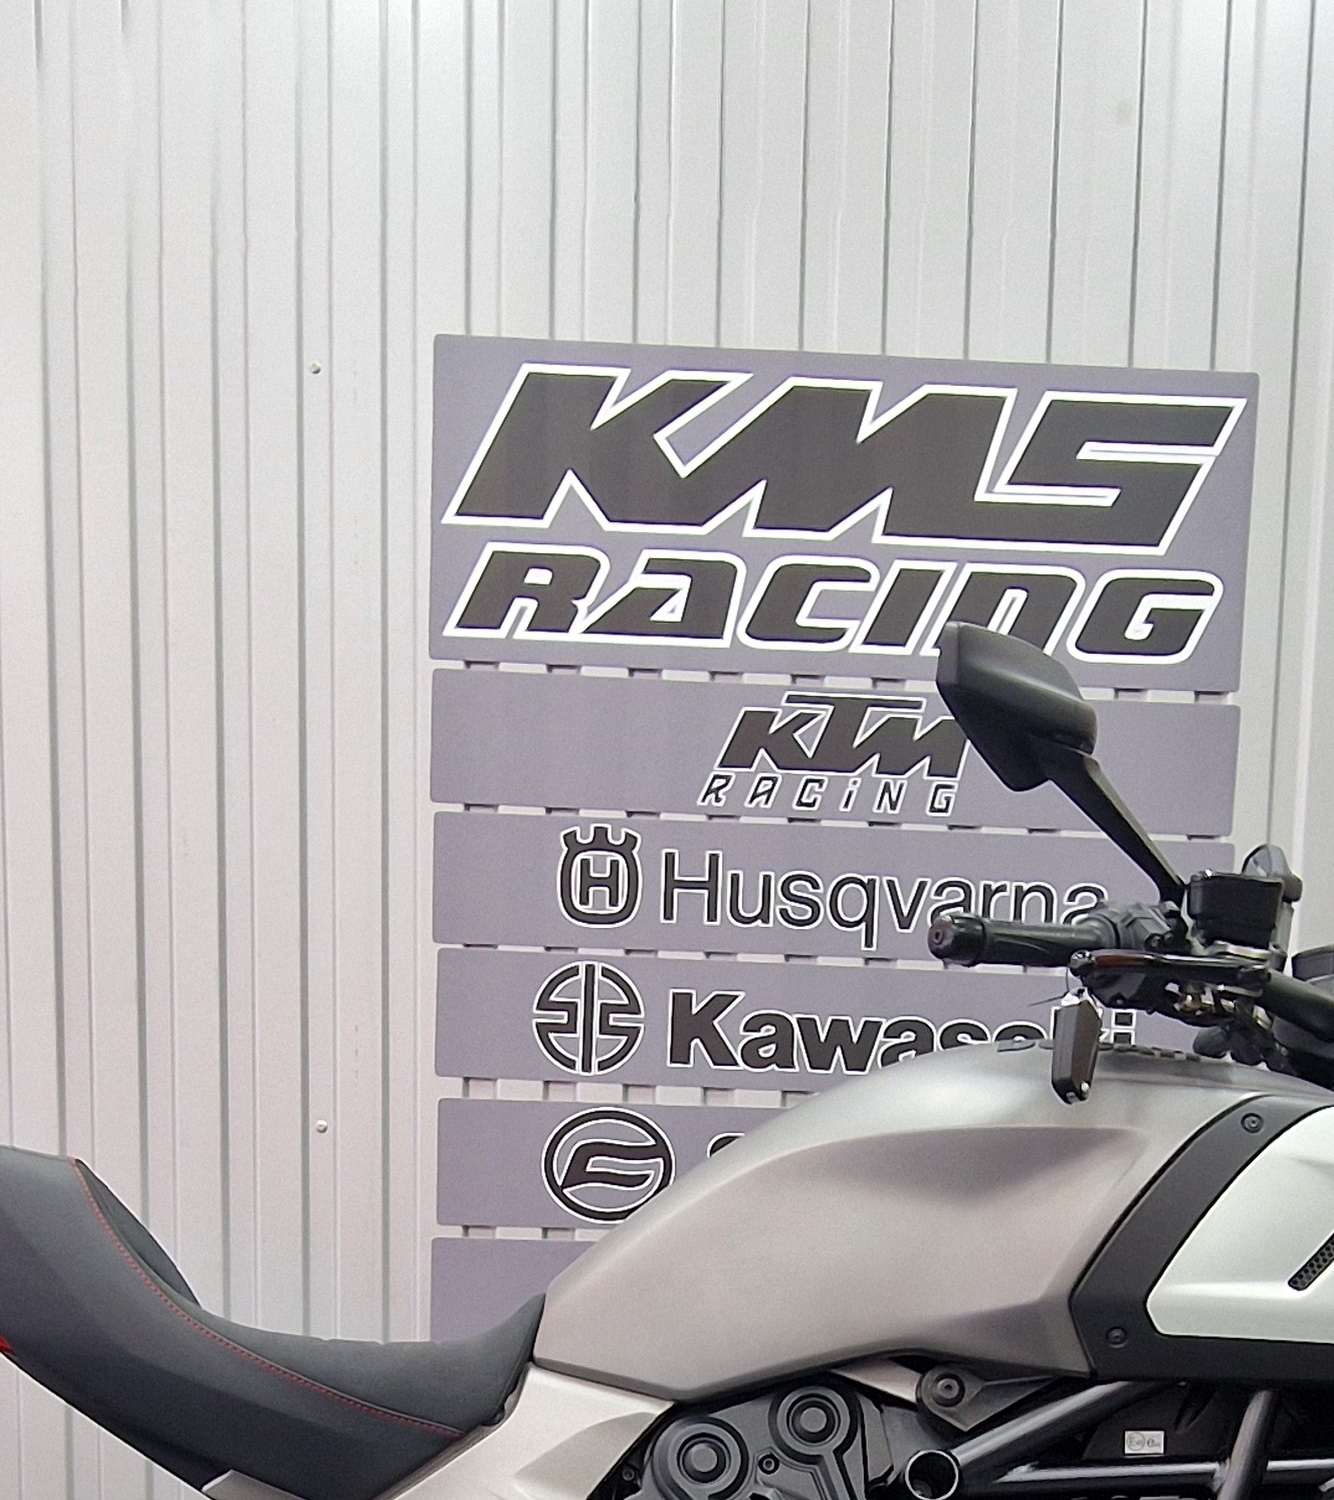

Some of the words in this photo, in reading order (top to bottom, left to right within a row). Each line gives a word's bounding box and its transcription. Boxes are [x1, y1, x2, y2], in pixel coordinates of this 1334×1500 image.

[440, 362, 1247, 556] KMS
[442, 541, 1224, 664] RACING
[713, 690, 970, 780] KTM
[660, 849, 1108, 950] Husqvarna
[665, 988, 1137, 1072] Kawa
